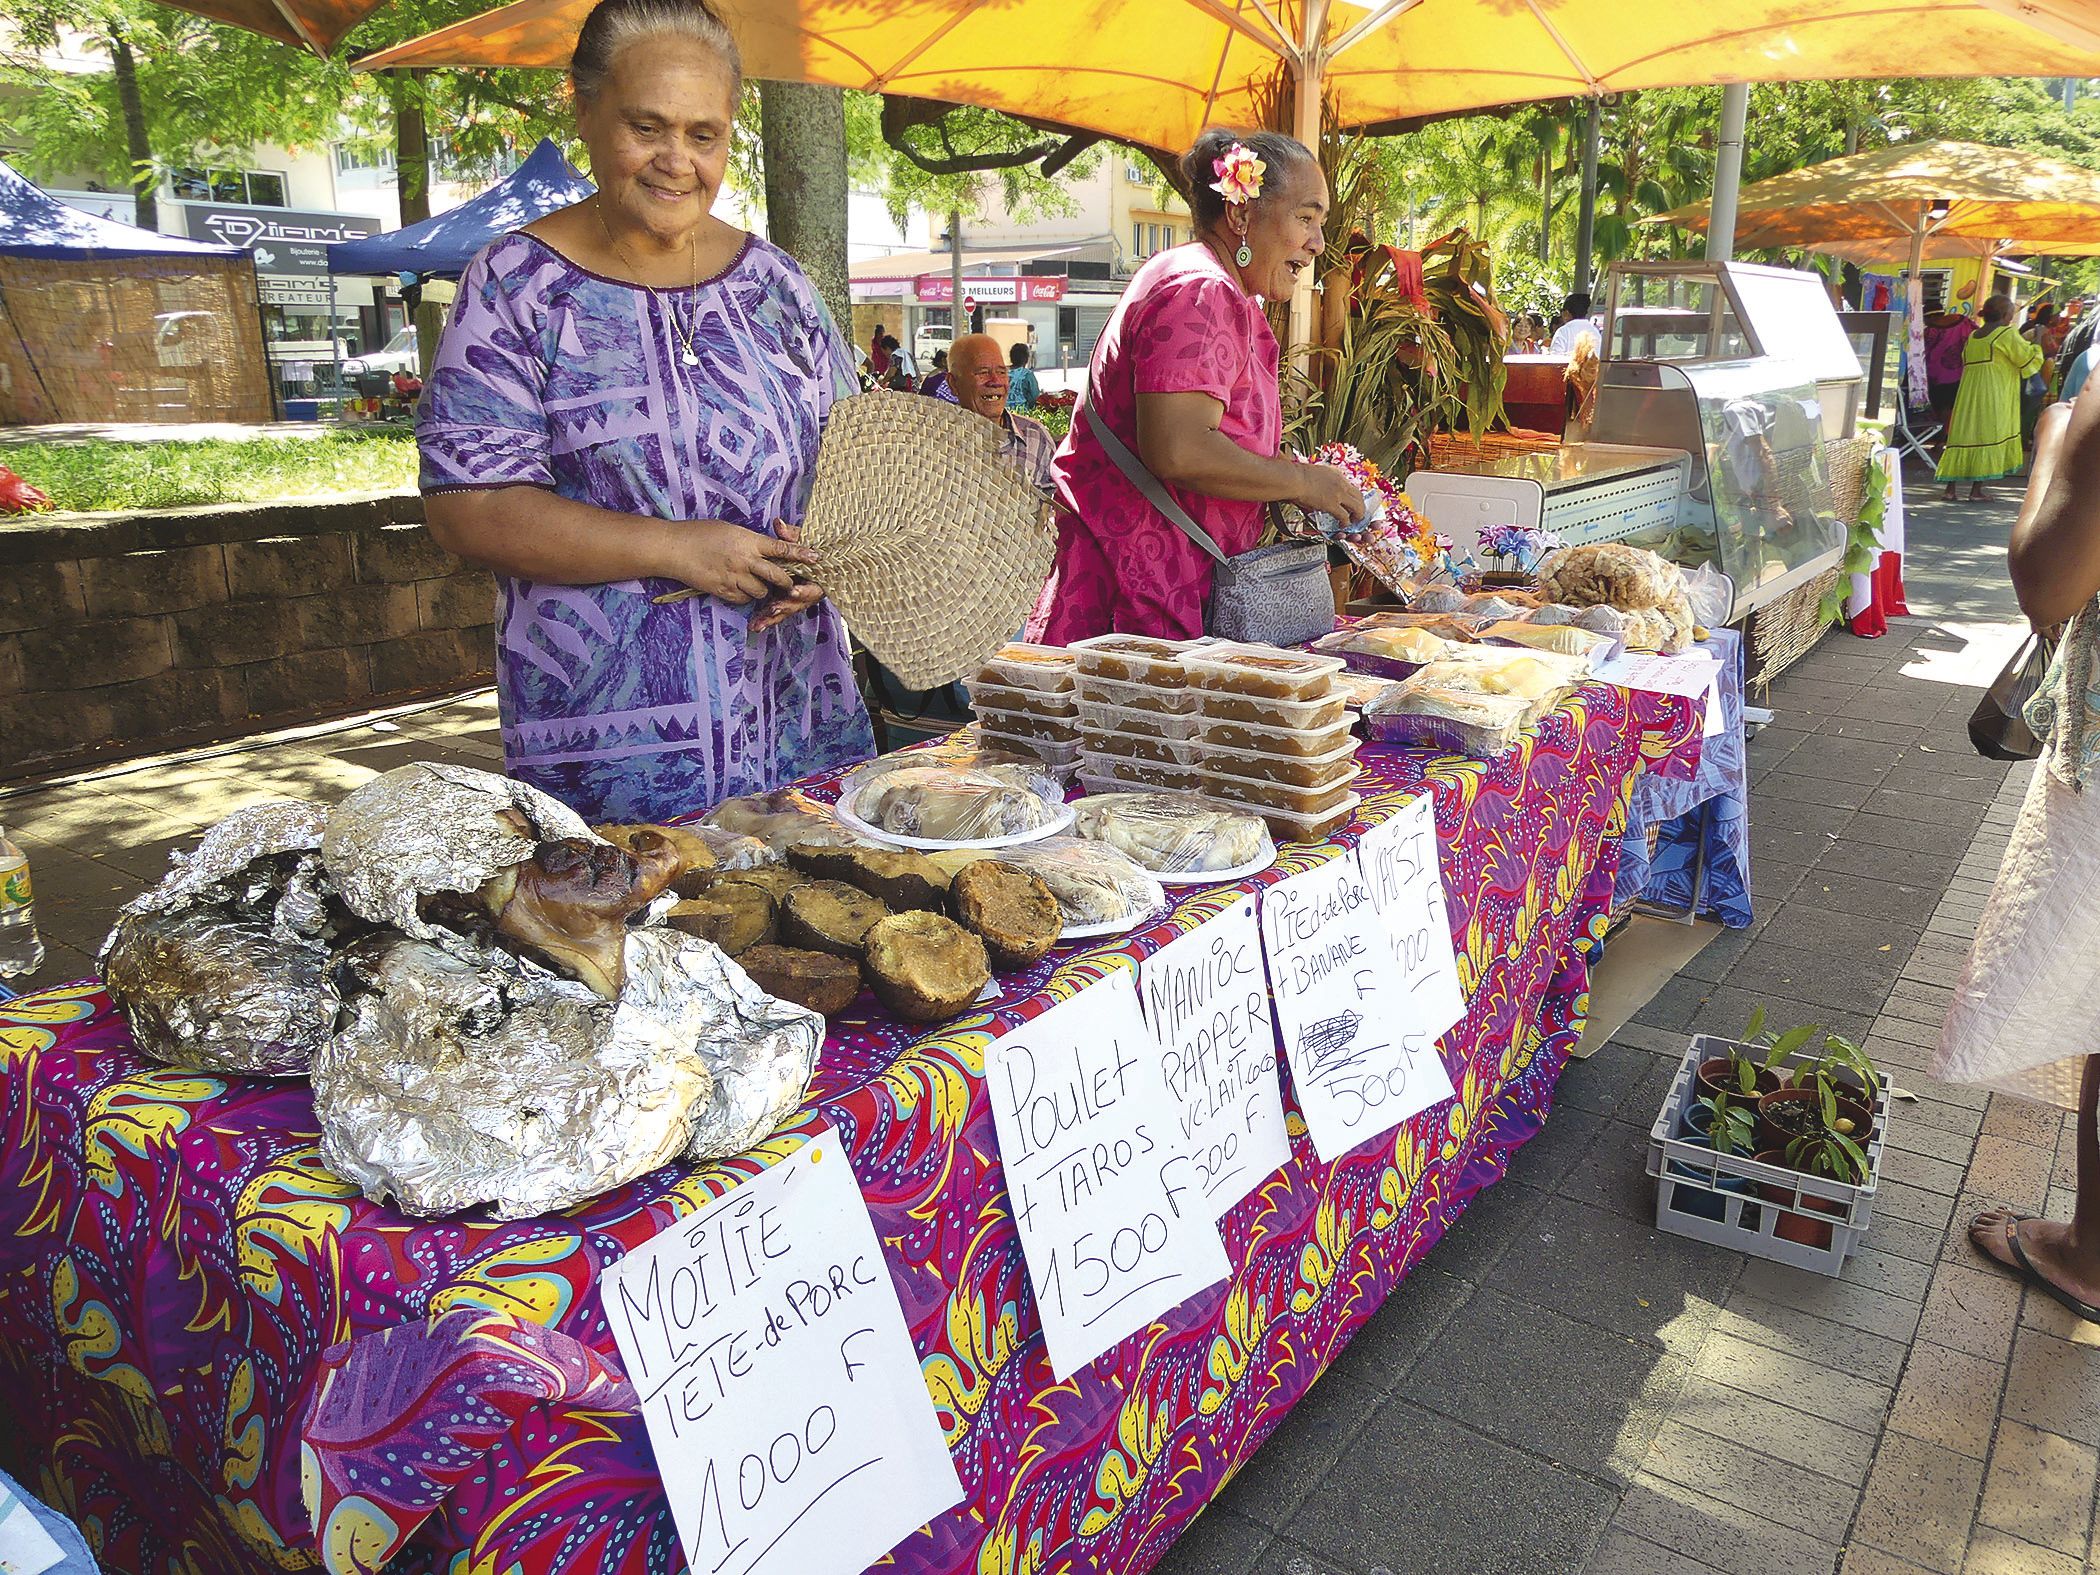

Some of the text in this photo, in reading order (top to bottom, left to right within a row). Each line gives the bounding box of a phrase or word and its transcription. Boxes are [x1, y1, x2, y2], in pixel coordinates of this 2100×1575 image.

[289, 247, 320, 256] Bijouterie
[299, 259, 329, 267] www.dia
[968, 287, 1015, 296] MEILLEURS
[1151, 936, 1255, 1047] MANIOC
[1291, 934, 1367, 995] BANANE
[1161, 991, 1269, 1103] RAPPER
[1323, 1066, 1406, 1127] 500
[1039, 1156, 1189, 1317] 1500 F
[692, 1405, 837, 1575] 1000
